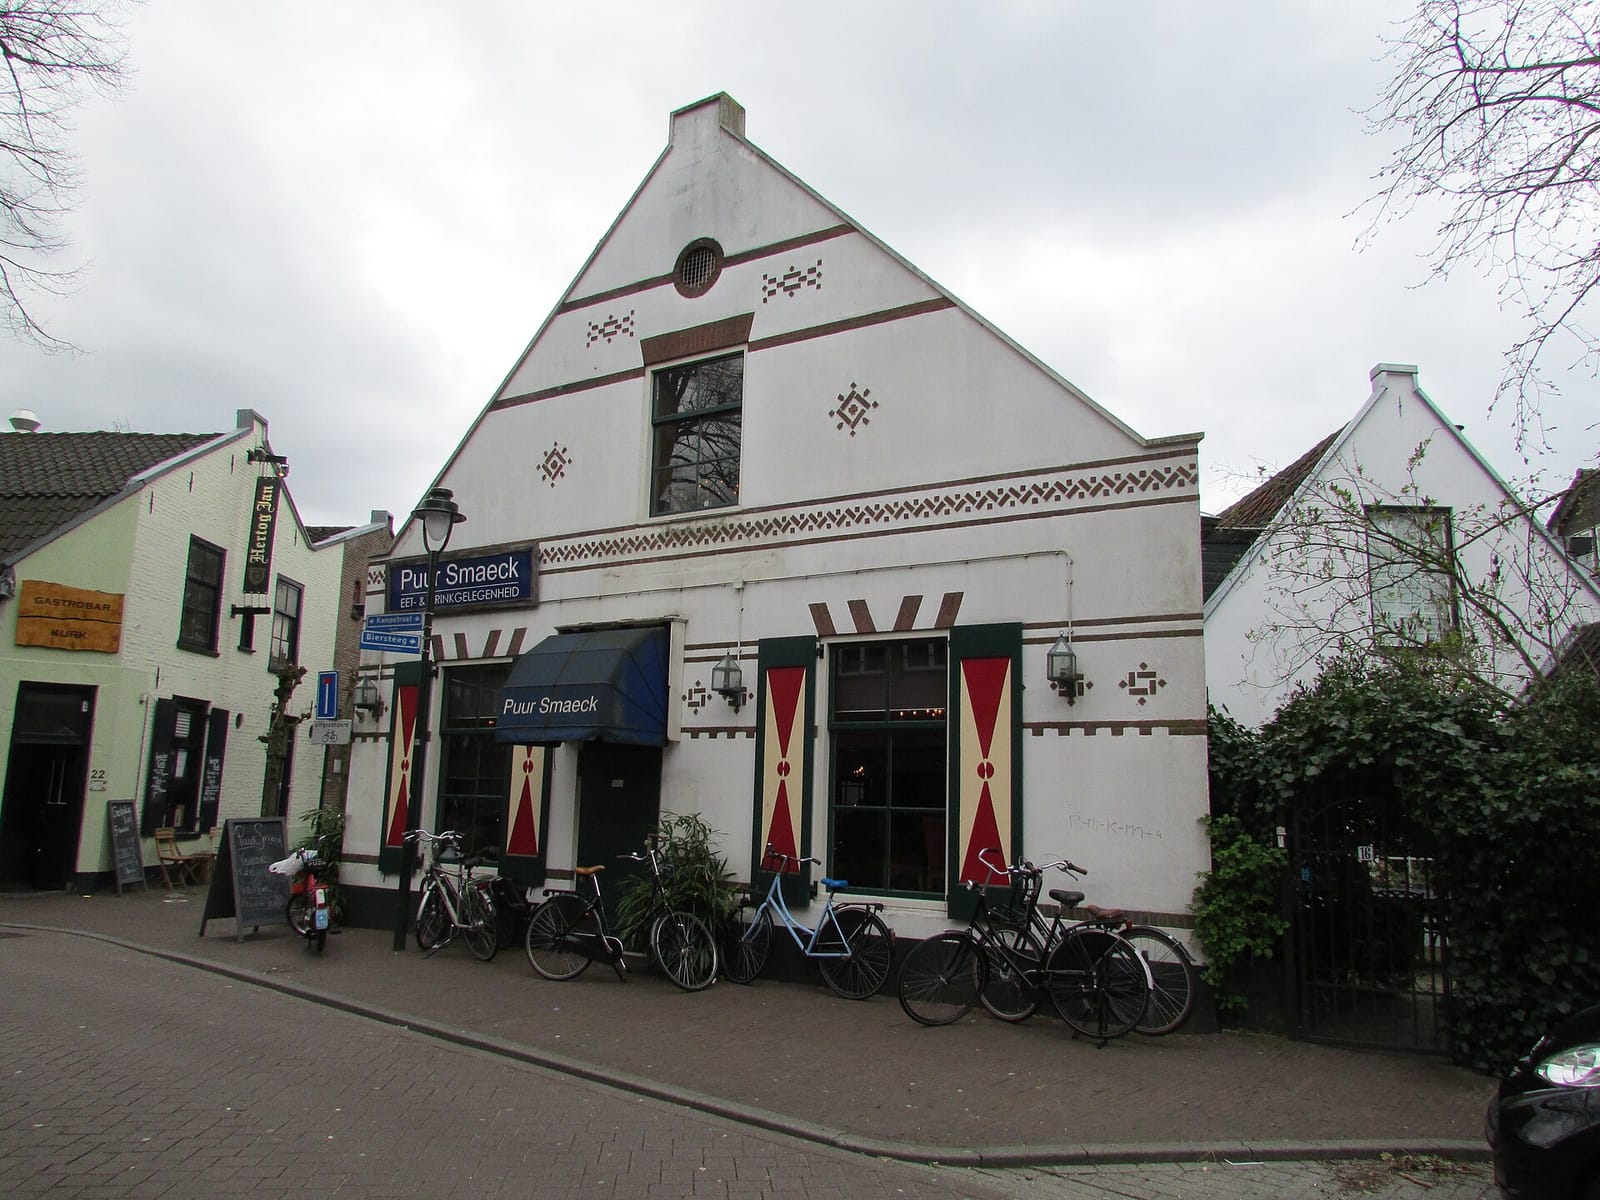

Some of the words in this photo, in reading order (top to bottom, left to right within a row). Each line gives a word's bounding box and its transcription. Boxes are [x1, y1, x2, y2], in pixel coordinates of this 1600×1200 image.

[256, 485, 275, 513] Jan
[250, 514, 272, 564] Hertog
[446, 556, 519, 585] Smaeck
[34, 596, 111, 611] GASTROBAR
[400, 597, 416, 608] EET-
[419, 596, 425, 607] &
[434, 587, 519, 605] RINKGELEGENHEID
[51, 629, 87, 639] KURK
[366, 633, 407, 645] Biersteeg
[503, 699, 536, 715] Puur
[539, 695, 598, 714] Smaeck
[91, 769, 105, 779] 22
[1360, 846, 1371, 860] 16
